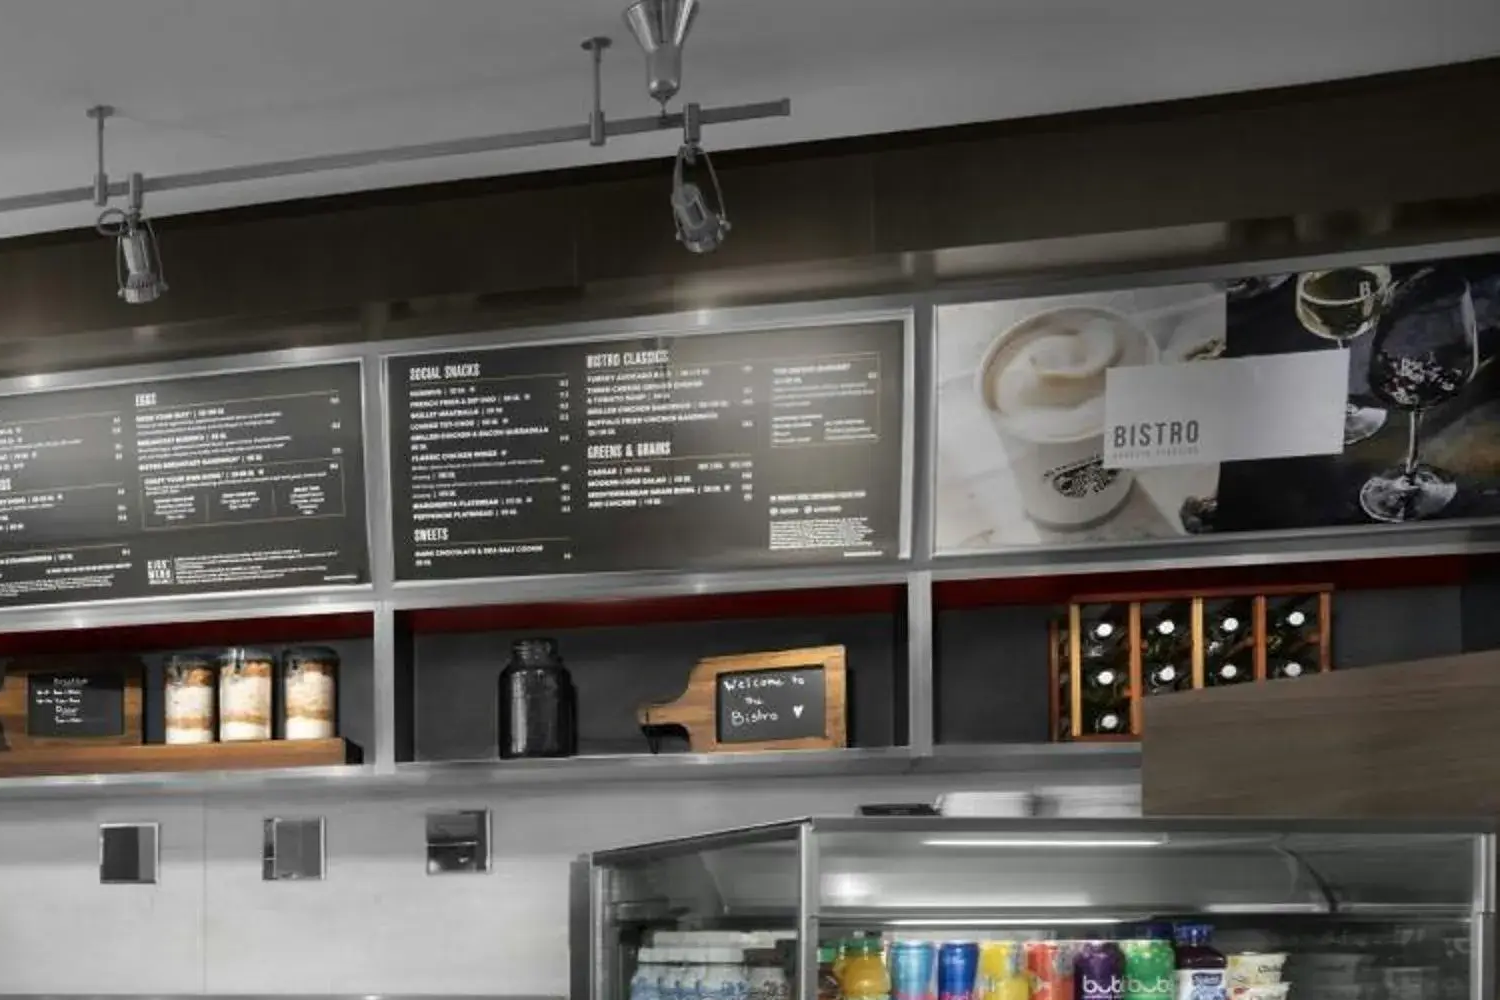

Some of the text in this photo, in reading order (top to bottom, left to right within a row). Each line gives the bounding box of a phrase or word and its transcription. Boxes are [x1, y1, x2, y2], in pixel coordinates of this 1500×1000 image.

[1113, 420, 1199, 448] BISTRO
[723, 677, 785, 691] Welcome
[731, 709, 779, 727] Bistro
